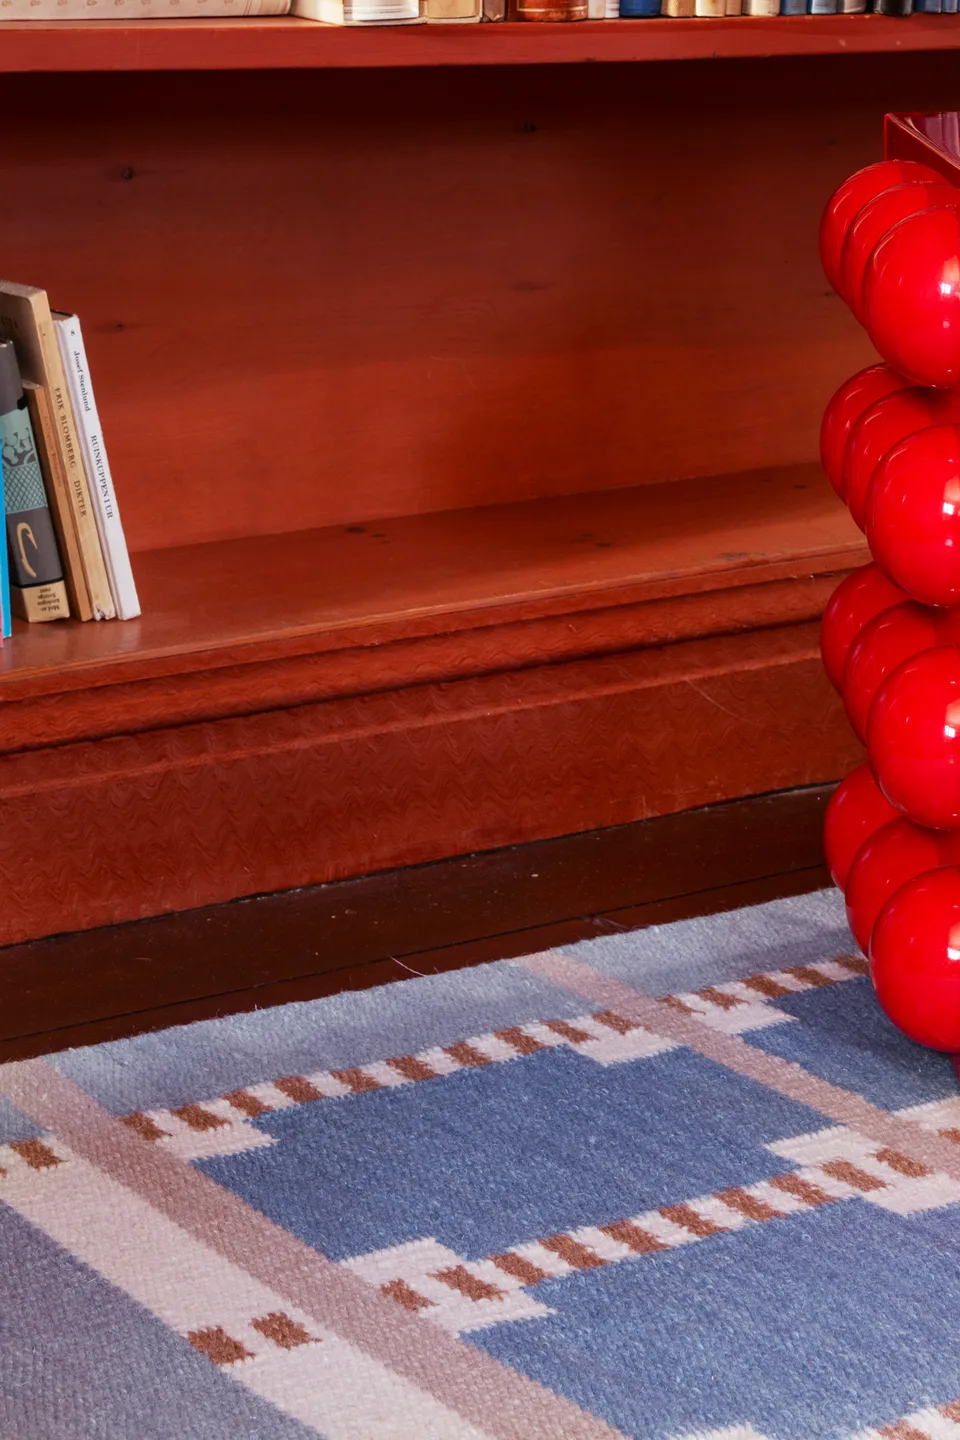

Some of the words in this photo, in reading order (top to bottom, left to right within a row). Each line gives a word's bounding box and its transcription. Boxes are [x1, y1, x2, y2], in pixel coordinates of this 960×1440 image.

[54, 387, 65, 411] ERIK
[60, 414, 76, 469] BLOMBERG
[73, 479, 87, 519] DIKTER
[73, 350, 84, 375] Josef
[79, 375, 91, 413] Stenlund
[91, 435, 109, 498] RUINKUPPEN
